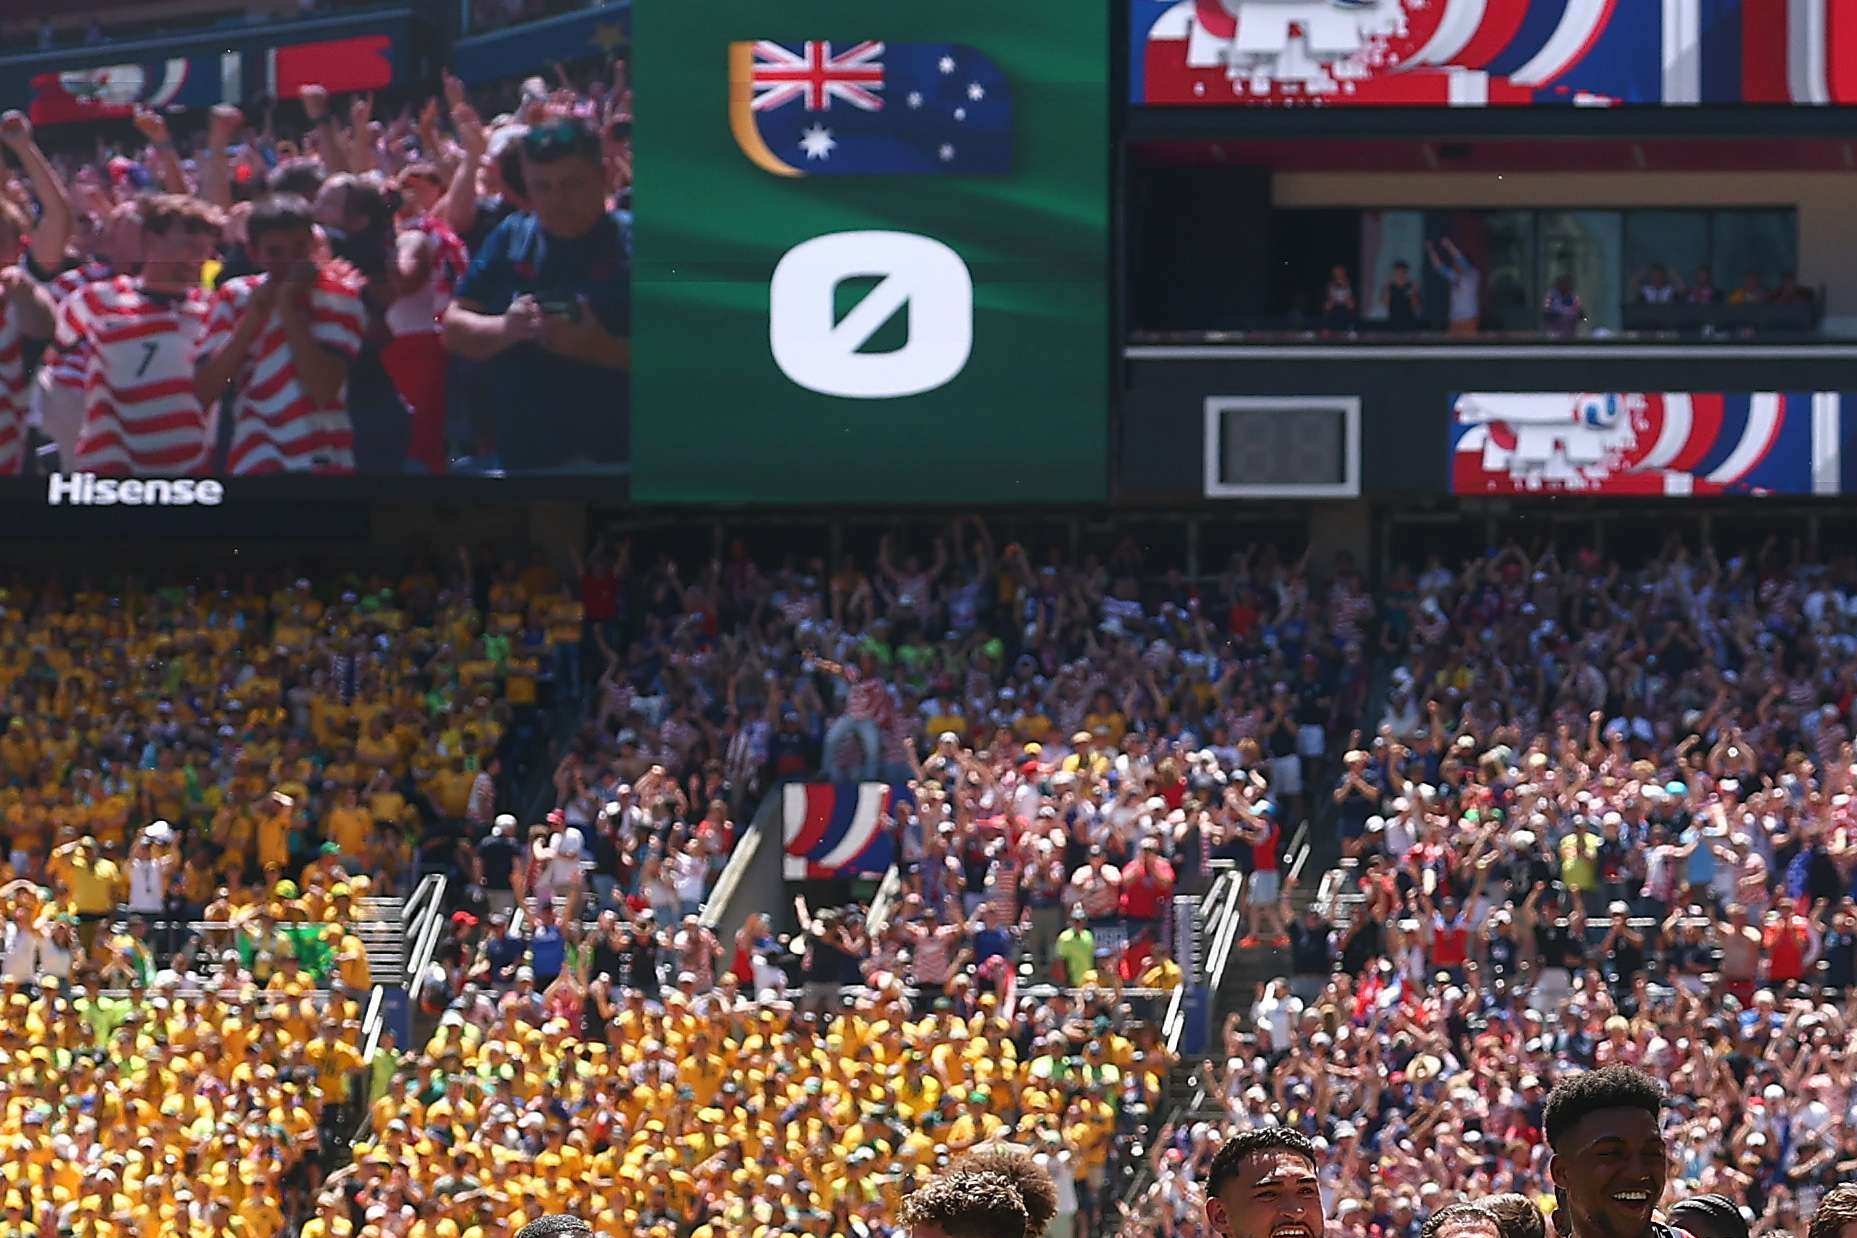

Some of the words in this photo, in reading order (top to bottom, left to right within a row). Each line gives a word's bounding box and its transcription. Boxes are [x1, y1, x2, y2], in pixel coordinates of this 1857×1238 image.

[770, 230, 972, 397] 0
[131, 341, 158, 378] 7
[49, 472, 224, 505] Hisense
